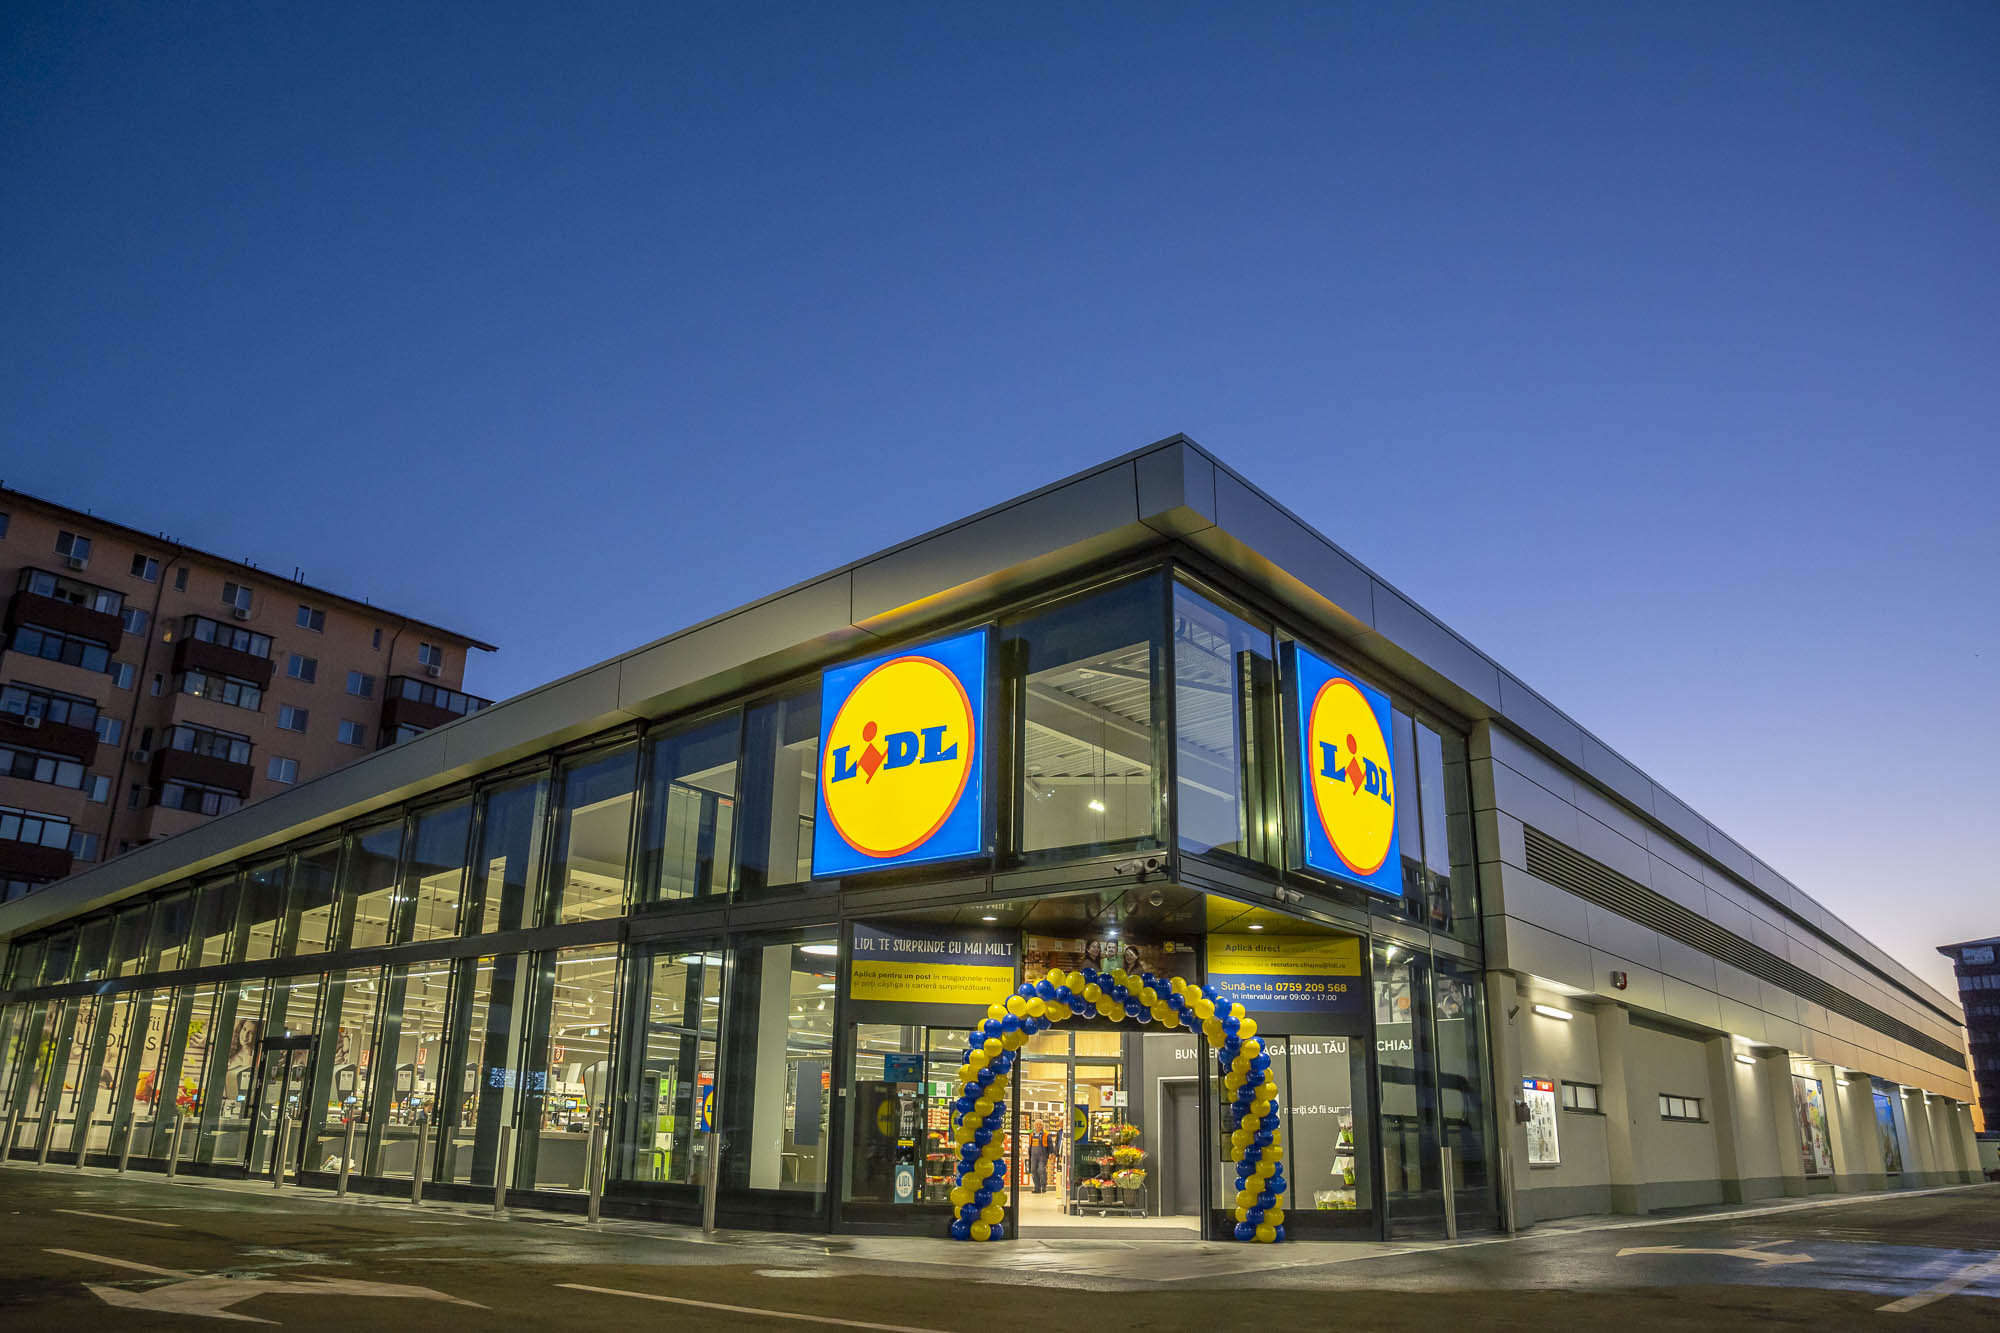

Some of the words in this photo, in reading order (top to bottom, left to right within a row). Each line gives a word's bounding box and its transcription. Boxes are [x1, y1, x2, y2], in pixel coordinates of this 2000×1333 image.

[832, 721, 957, 784] LIDL
[1320, 734, 1391, 806] LIDL
[854, 937, 875, 951] LIDL
[878, 938, 890, 951] TE
[893, 939, 945, 953] SURPRINDE
[948, 941, 961, 954] CU
[964, 942, 983, 955] MAI
[984, 943, 1013, 956] MULT
[1224, 943, 1252, 953] Aplică
[1255, 944, 1280, 953] direct
[853, 970, 876, 979] Aplică
[878, 972, 902, 980] pentru
[915, 973, 931, 981] post
[1220, 981, 1261, 991] Sună-ne
[1264, 982, 1273, 991] la
[1275, 982, 1302, 992] 0759
[1305, 983, 1325, 992] 209
[1327, 983, 1347, 993] 568
[1289, 993, 1310, 1001] 09:00
[1175, 1048, 1198, 1060] BUN
[1262, 1043, 1321, 1056] AGAZINUL
[1322, 1040, 1346, 1055] TĂU
